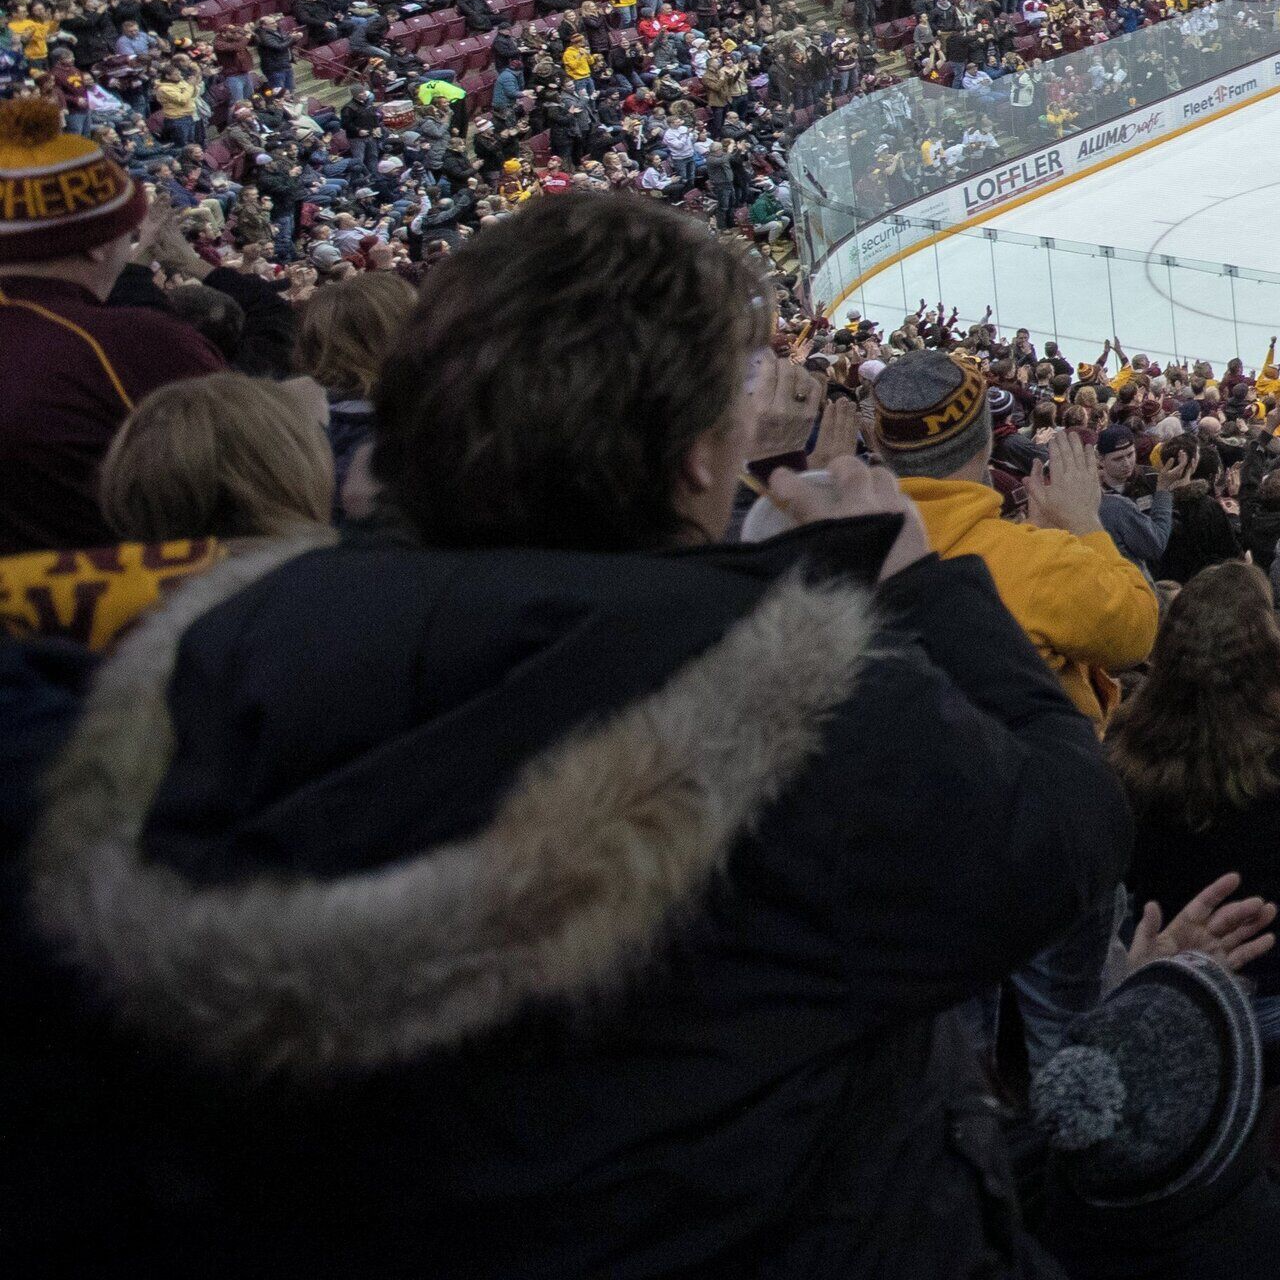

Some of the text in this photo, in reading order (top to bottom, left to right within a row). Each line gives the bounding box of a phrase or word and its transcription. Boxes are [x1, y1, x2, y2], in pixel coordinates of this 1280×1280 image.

[1183, 77, 1258, 119] Fleet Farm
[963, 150, 1063, 208] LOFFLER
[861, 218, 911, 252] securian
